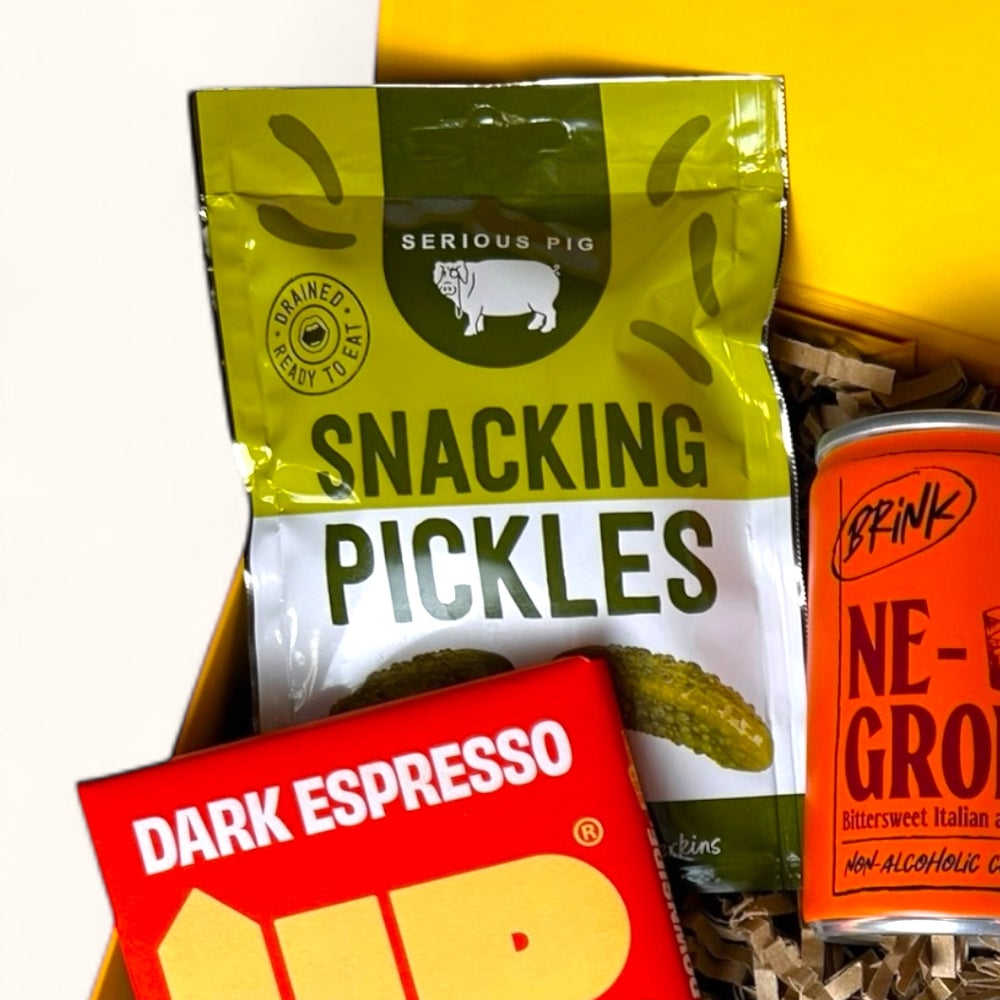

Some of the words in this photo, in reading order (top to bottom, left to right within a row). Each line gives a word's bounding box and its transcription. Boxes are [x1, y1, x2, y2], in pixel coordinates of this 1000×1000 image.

[401, 233, 530, 251] SERIOUS
[546, 234, 595, 252] PIG
[274, 281, 345, 325] DRAINED
[273, 344, 316, 387] READY
[322, 361, 347, 383] TO
[342, 323, 362, 360] EAT
[310, 402, 708, 499] SNACKING
[324, 510, 718, 626] PICKLES
[847, 598, 968, 700] NE-
[132, 784, 295, 876] DARK
[294, 719, 573, 836] ESPRESSO
[842, 807, 928, 831] Bittersweet
[933, 806, 989, 828] Italian
